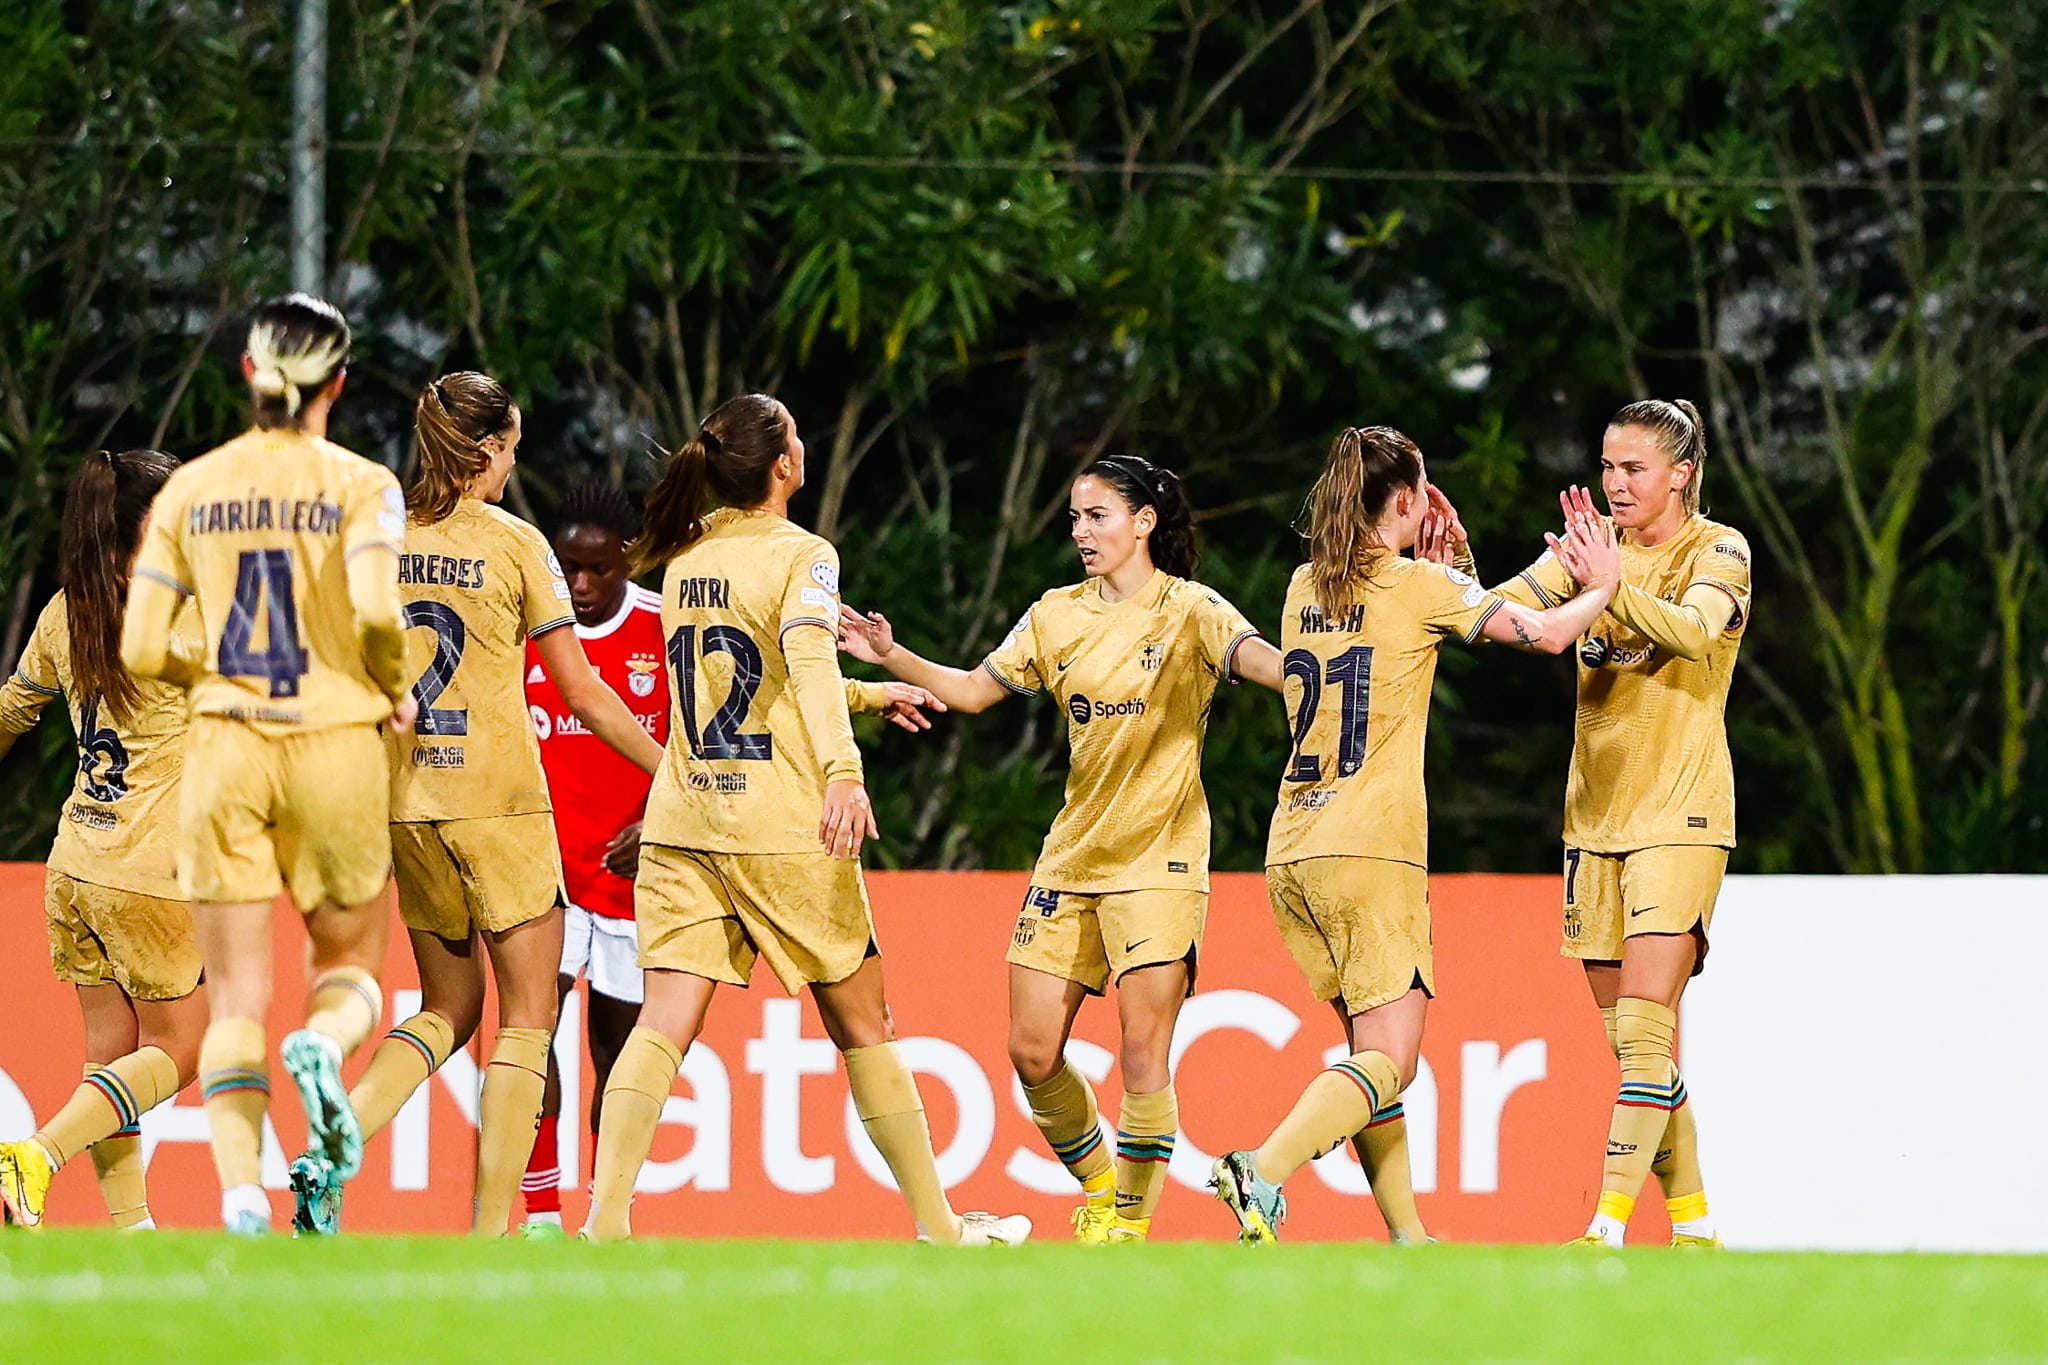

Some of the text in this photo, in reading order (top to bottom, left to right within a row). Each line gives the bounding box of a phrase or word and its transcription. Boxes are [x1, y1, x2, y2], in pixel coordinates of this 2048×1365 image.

[190, 487, 344, 536] MARÍA LEÓN
[398, 554, 484, 588] AREDES
[679, 577, 730, 609] PATRI
[219, 549, 309, 698] 4
[402, 600, 467, 736] 2
[668, 625, 772, 760] 12
[1095, 698, 1149, 719] Spotify
[80, 695, 129, 802] 6
[1283, 647, 1374, 782] 21
[1565, 849, 1580, 905] 7
